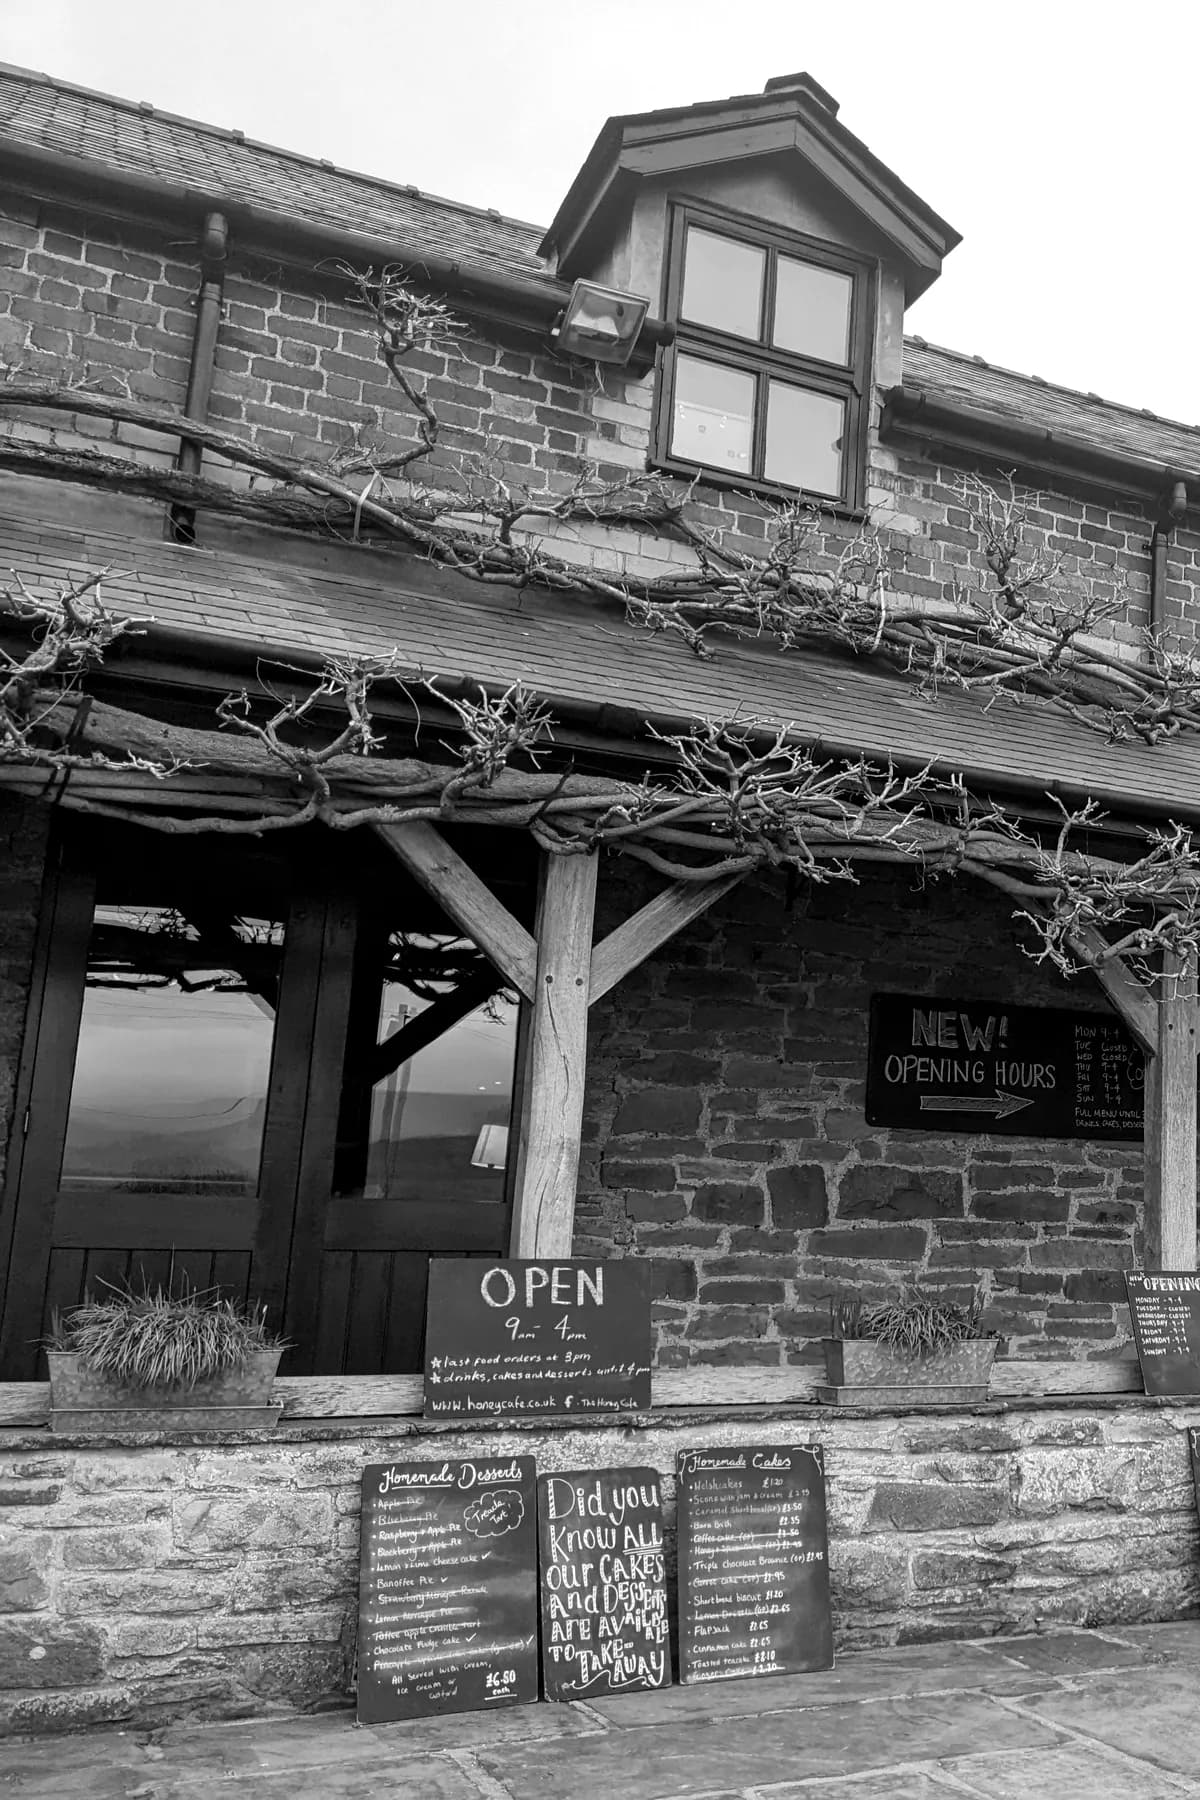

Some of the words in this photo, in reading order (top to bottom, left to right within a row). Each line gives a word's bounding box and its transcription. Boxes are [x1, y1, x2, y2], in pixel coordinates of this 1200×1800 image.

[911, 1007, 1009, 1051] NEW!
[1075, 1024, 1097, 1038] MON
[1101, 1053, 1128, 1062] CLOSED
[884, 1054, 985, 1084] OPENING
[995, 1060, 1056, 1089] HOURS
[1076, 1093, 1095, 1103] SUN
[1075, 1107, 1092, 1117] FULL
[1093, 1109, 1118, 1118] MENU
[1119, 1110, 1141, 1119] UNTIL
[480, 1266, 604, 1308] OPEN
[1138, 1319, 1168, 1327] THURSDAY
[1141, 1336, 1171, 1345] SATURDAY
[1143, 1348, 1167, 1356] SUNDAY
[444, 1355, 471, 1369] last
[474, 1354, 500, 1366] food
[504, 1354, 541, 1364] orders
[546, 1353, 559, 1361] at
[564, 1351, 591, 1363] 3pm
[493, 1369, 523, 1380] cakes
[525, 1368, 543, 1378] and
[544, 1367, 592, 1379] desserts
[597, 1363, 625, 1375] until
[431, 1395, 557, 1415] www.honeycafe.co.uk
[688, 1453, 746, 1473] Homemade
[752, 1452, 792, 1468] Cakes
[378, 1463, 455, 1493] Homemade
[458, 1460, 523, 1489] Desserts
[547, 1478, 607, 1520] Did
[608, 1484, 659, 1526] you
[693, 1494, 718, 1505] Scone
[695, 1504, 728, 1516] Caramel
[550, 1524, 616, 1563] Know
[624, 1522, 664, 1549] ALL
[599, 1553, 664, 1584] CAKES
[693, 1560, 718, 1572] Triple
[377, 1577, 415, 1589] Banoffee
[419, 1575, 435, 1586] Pie
[442, 1637, 460, 1646] cake
[693, 1644, 730, 1654] Cinnamon
[391, 1675, 403, 1685] All
[439, 1665, 459, 1674] with
[416, 1681, 441, 1692] cream
